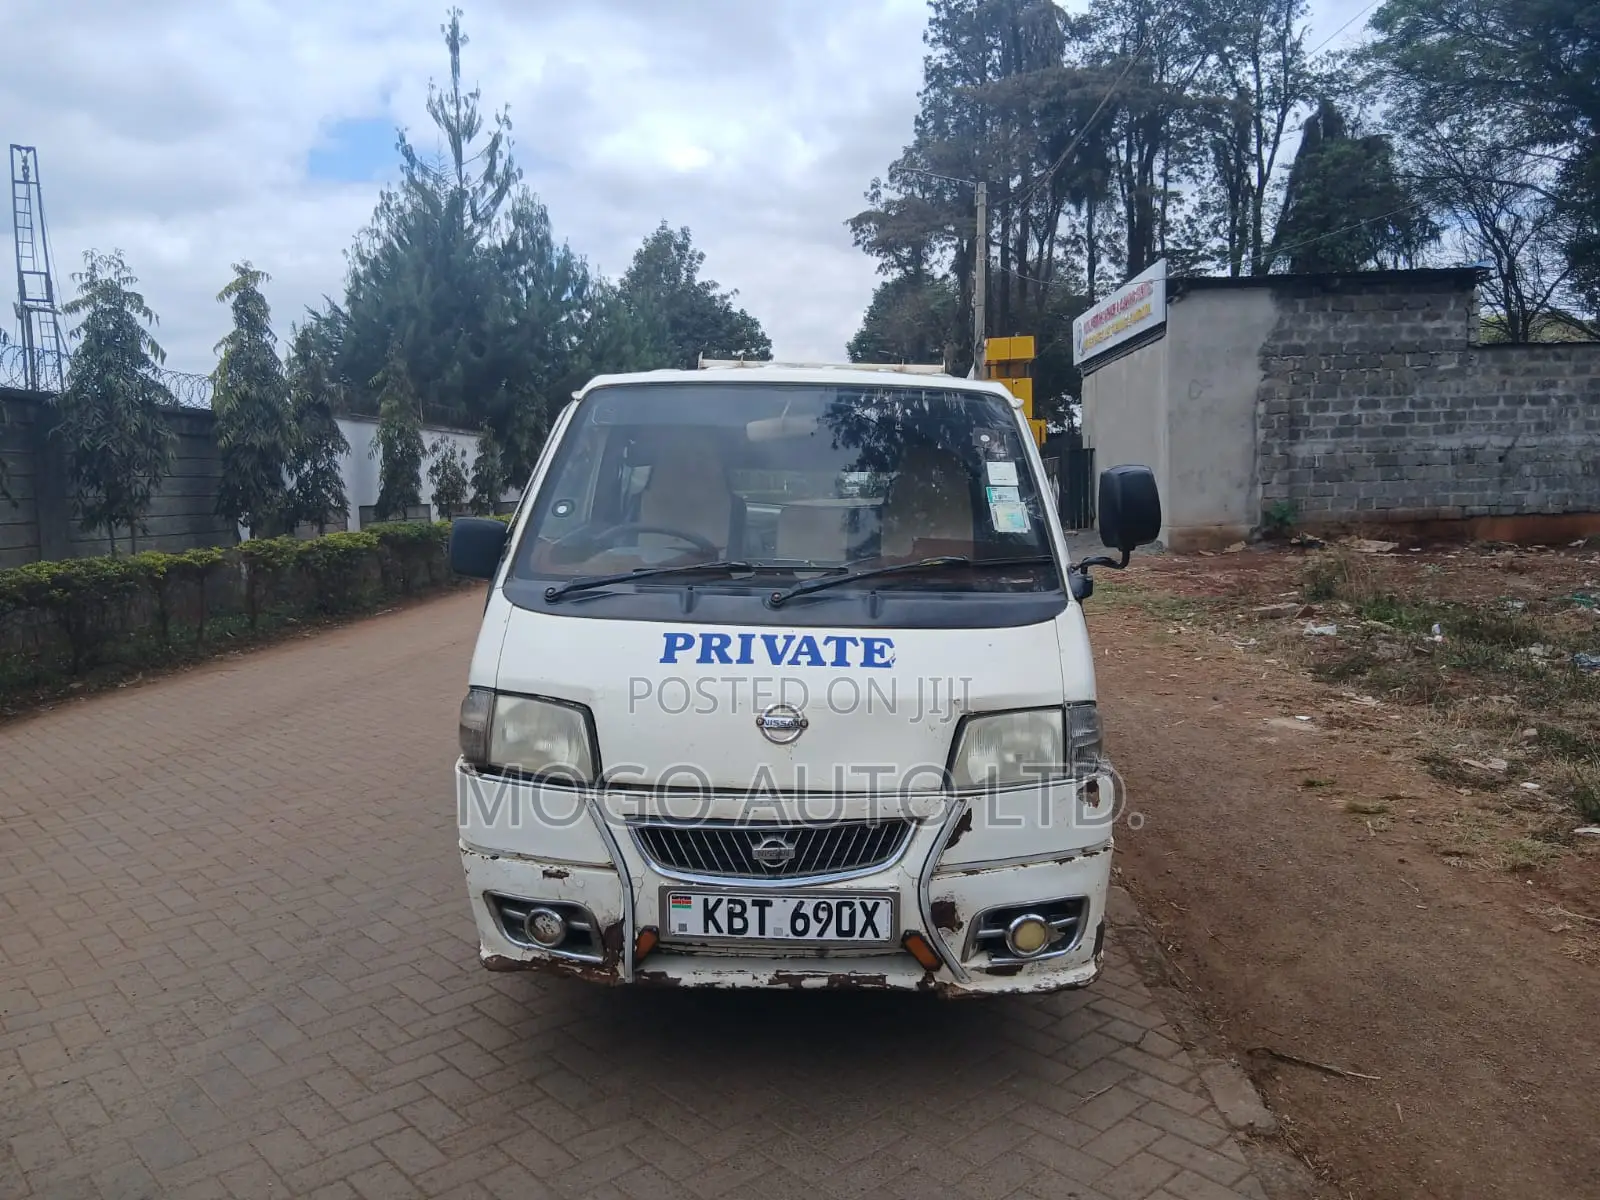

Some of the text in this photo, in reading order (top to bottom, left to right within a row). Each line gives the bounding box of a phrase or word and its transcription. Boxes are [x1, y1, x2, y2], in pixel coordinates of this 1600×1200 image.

[659, 632, 897, 668] PRIVATE
[764, 718, 800, 727] NISSAN
[703, 898, 880, 938] KBT 690X
